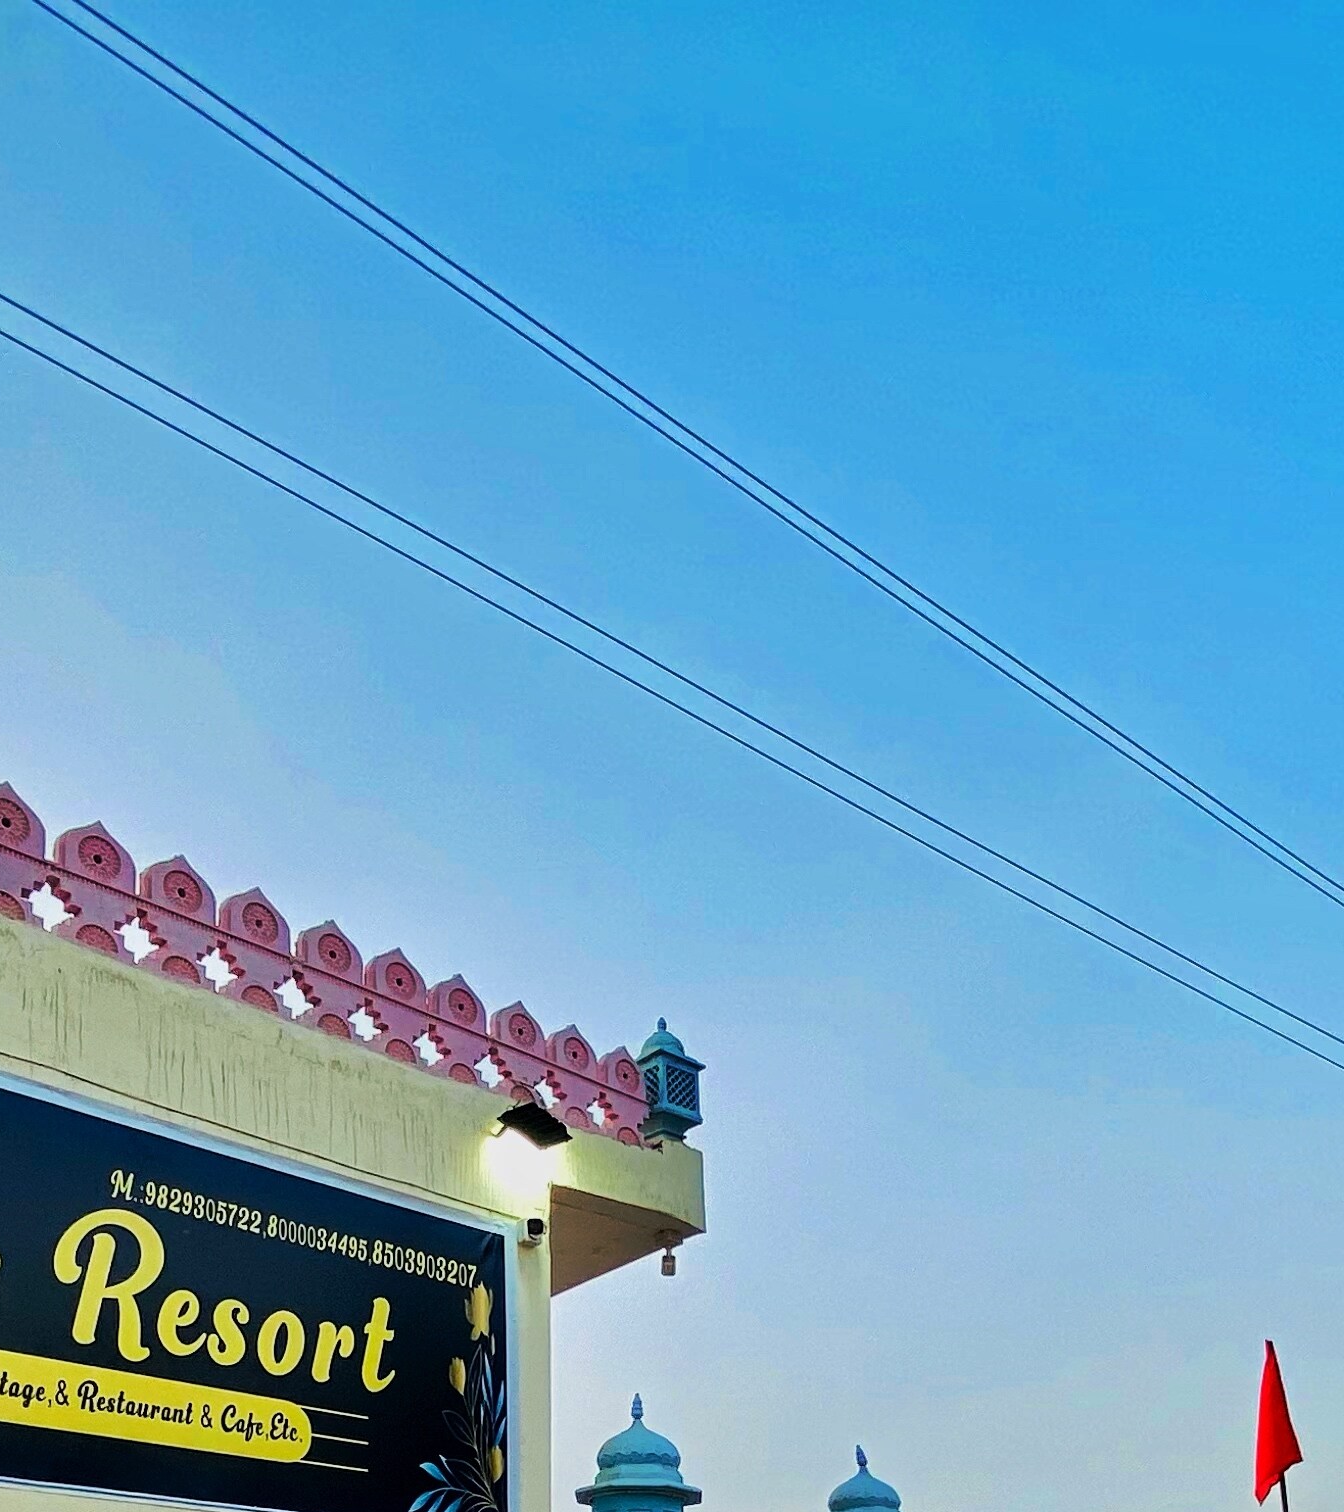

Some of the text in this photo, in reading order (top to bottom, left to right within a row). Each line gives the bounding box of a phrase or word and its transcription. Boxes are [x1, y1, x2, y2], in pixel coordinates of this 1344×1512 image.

[53, 1208, 396, 1393] Resort
[77, 1379, 195, 1427] Restaurant
[200, 1404, 214, 1429] &
